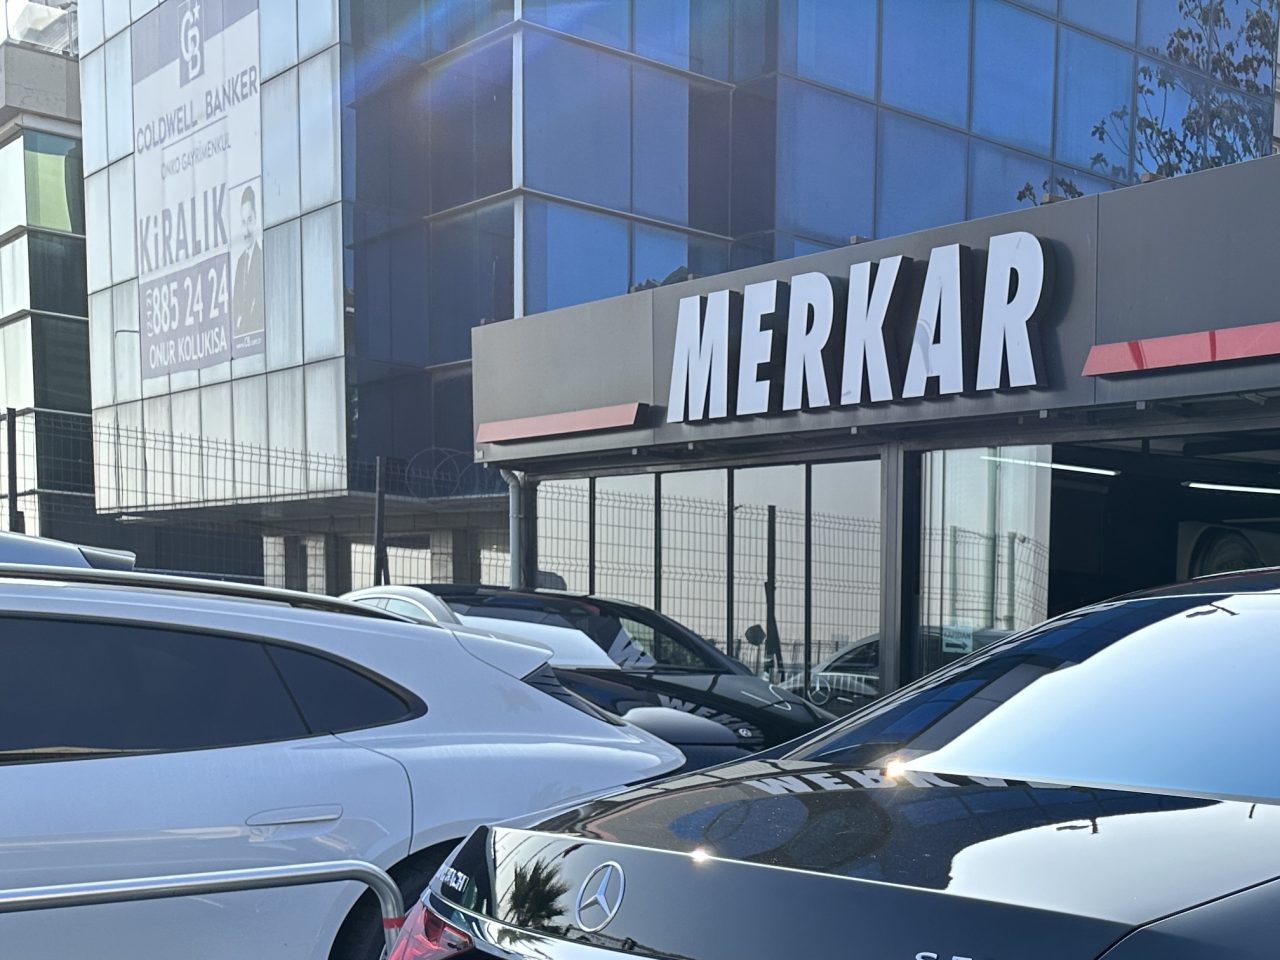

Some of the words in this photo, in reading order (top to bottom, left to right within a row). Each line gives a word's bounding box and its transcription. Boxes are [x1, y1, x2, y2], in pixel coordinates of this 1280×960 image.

[136, 99, 198, 155] COLDWELL
[205, 65, 258, 120] BANKER
[152, 281, 179, 335] 885
[183, 273, 203, 326] 24
[208, 263, 229, 319] 24
[666, 230, 1046, 424] MERKAR
[149, 340, 176, 369] ONUR
